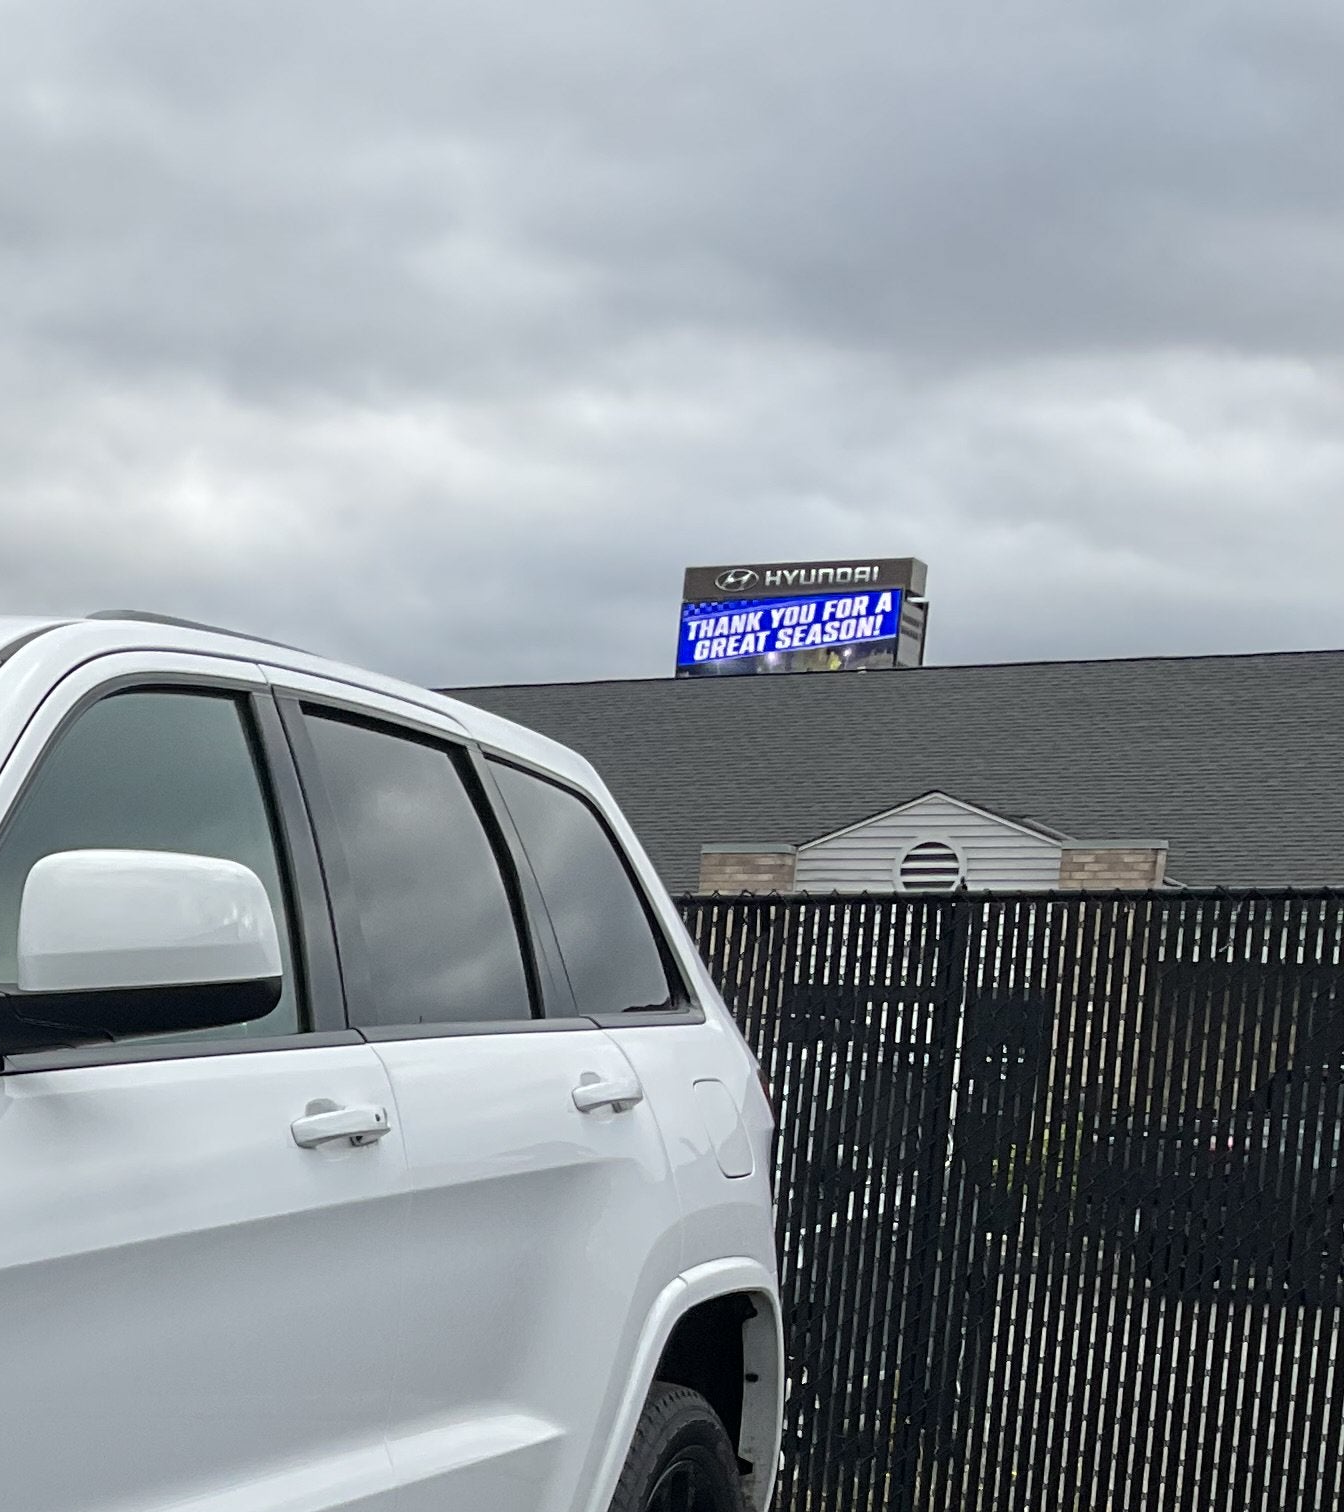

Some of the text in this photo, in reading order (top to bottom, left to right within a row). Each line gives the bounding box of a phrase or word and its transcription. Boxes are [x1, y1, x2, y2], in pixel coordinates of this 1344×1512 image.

[765, 566, 880, 587] HYUNDAI
[687, 592, 893, 641] THANK YOU FOR A
[693, 630, 771, 662] GREAT
[774, 615, 882, 650] SEASON!
